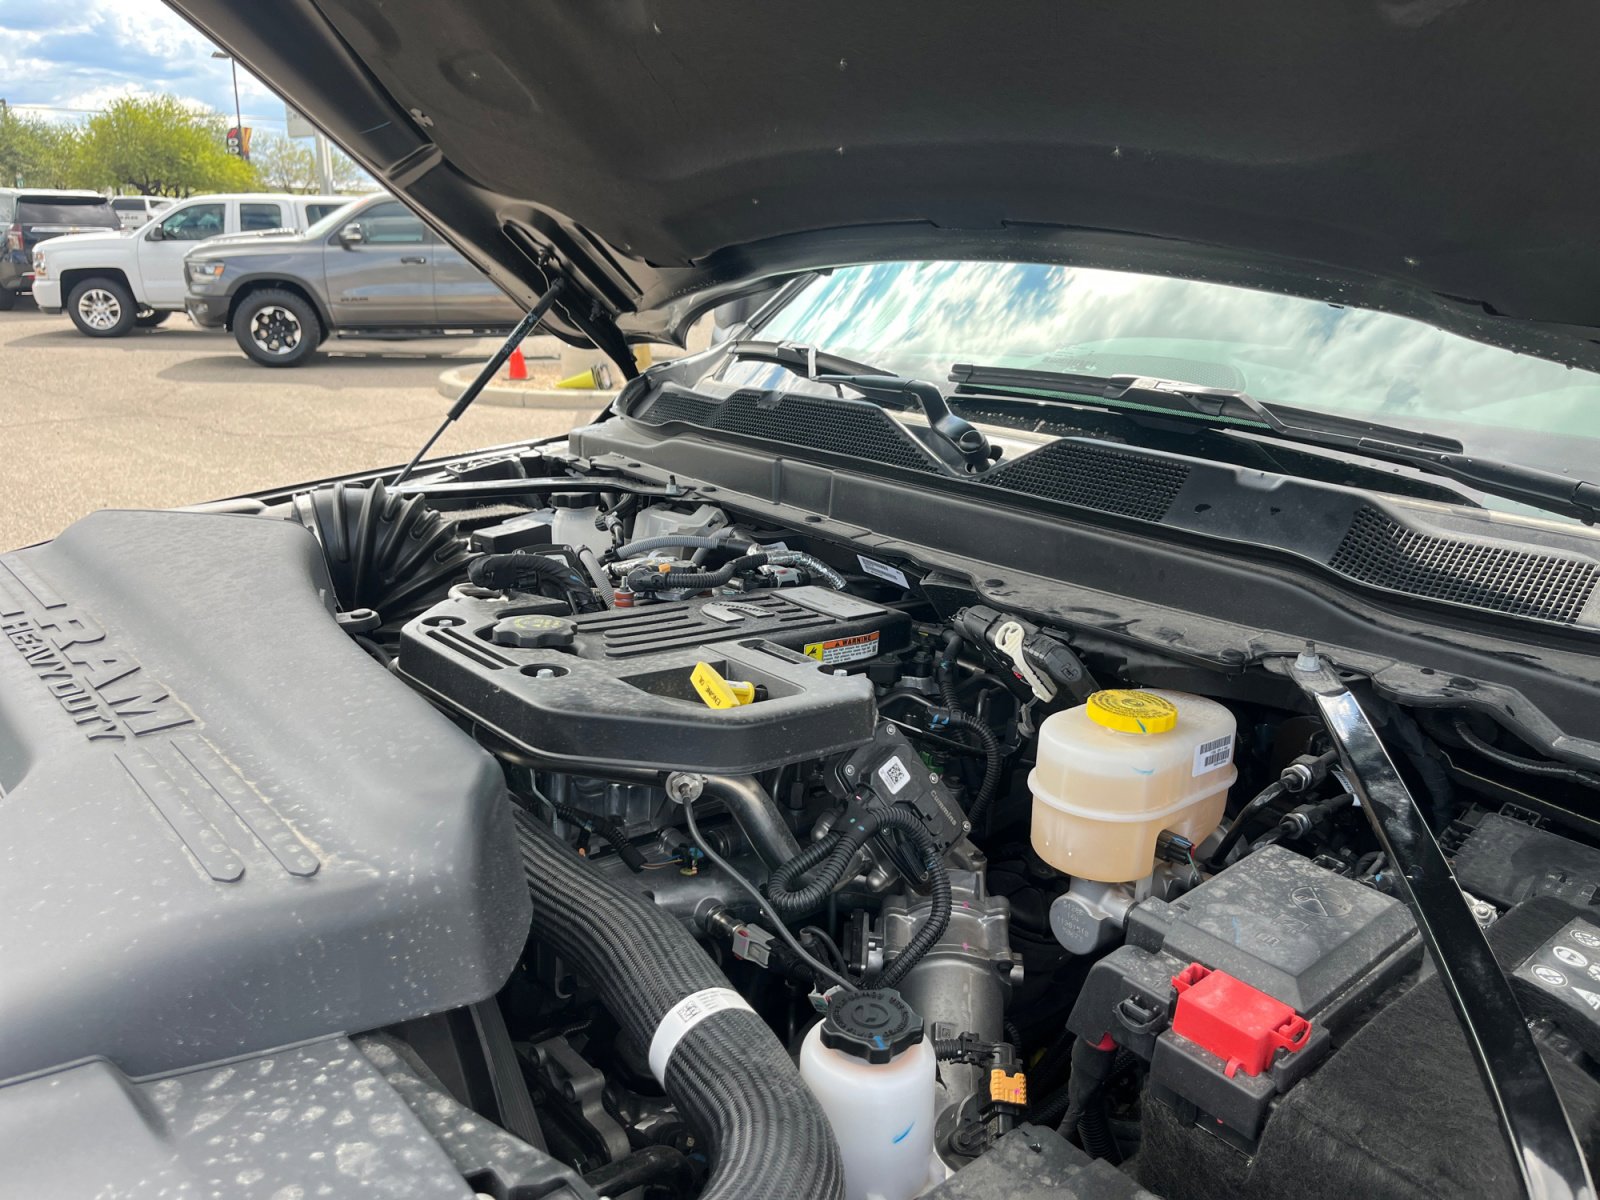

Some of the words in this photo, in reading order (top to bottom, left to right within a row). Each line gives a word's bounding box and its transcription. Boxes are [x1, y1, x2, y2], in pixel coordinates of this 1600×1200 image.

[0, 620, 73, 680] HEAVY
[48, 678, 126, 742] DUTY
[33, 609, 196, 737] RAM
[842, 634, 872, 647] WARNING
